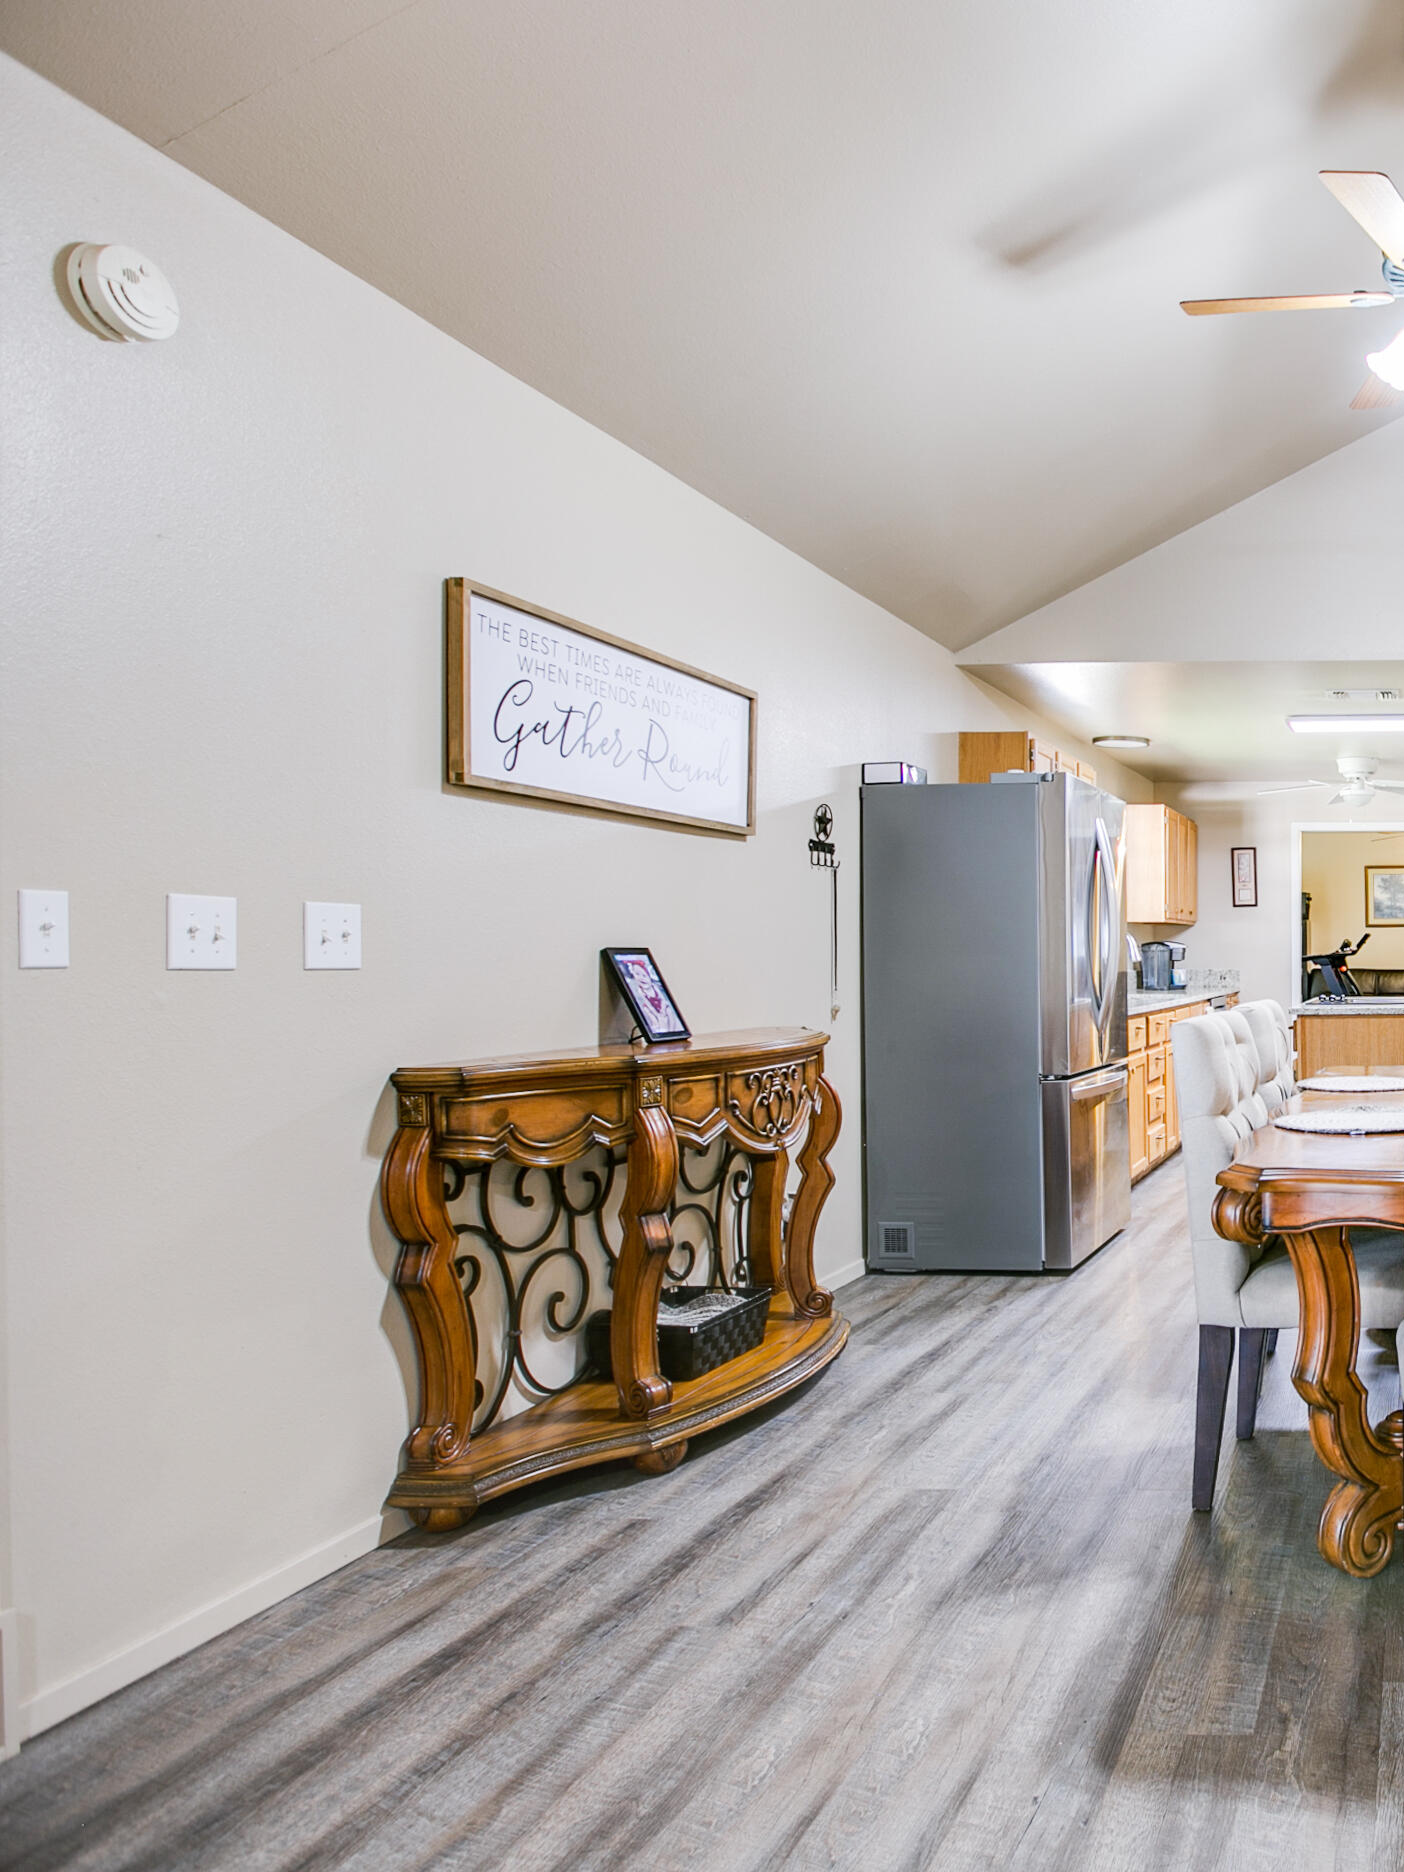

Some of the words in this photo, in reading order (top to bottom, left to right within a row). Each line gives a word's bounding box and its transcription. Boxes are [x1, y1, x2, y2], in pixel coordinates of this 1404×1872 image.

[477, 613, 512, 643] THE
[519, 628, 559, 658] BEST
[566, 644, 610, 676] TIMES
[615, 664, 642, 687] ARE
[647, 676, 698, 707] ALWAYS
[517, 653, 569, 686] WHEN
[576, 673, 637, 708] FRIENDS
[642, 696, 671, 718] AND
[494, 679, 633, 772] Gather
[637, 718, 730, 793] Round
